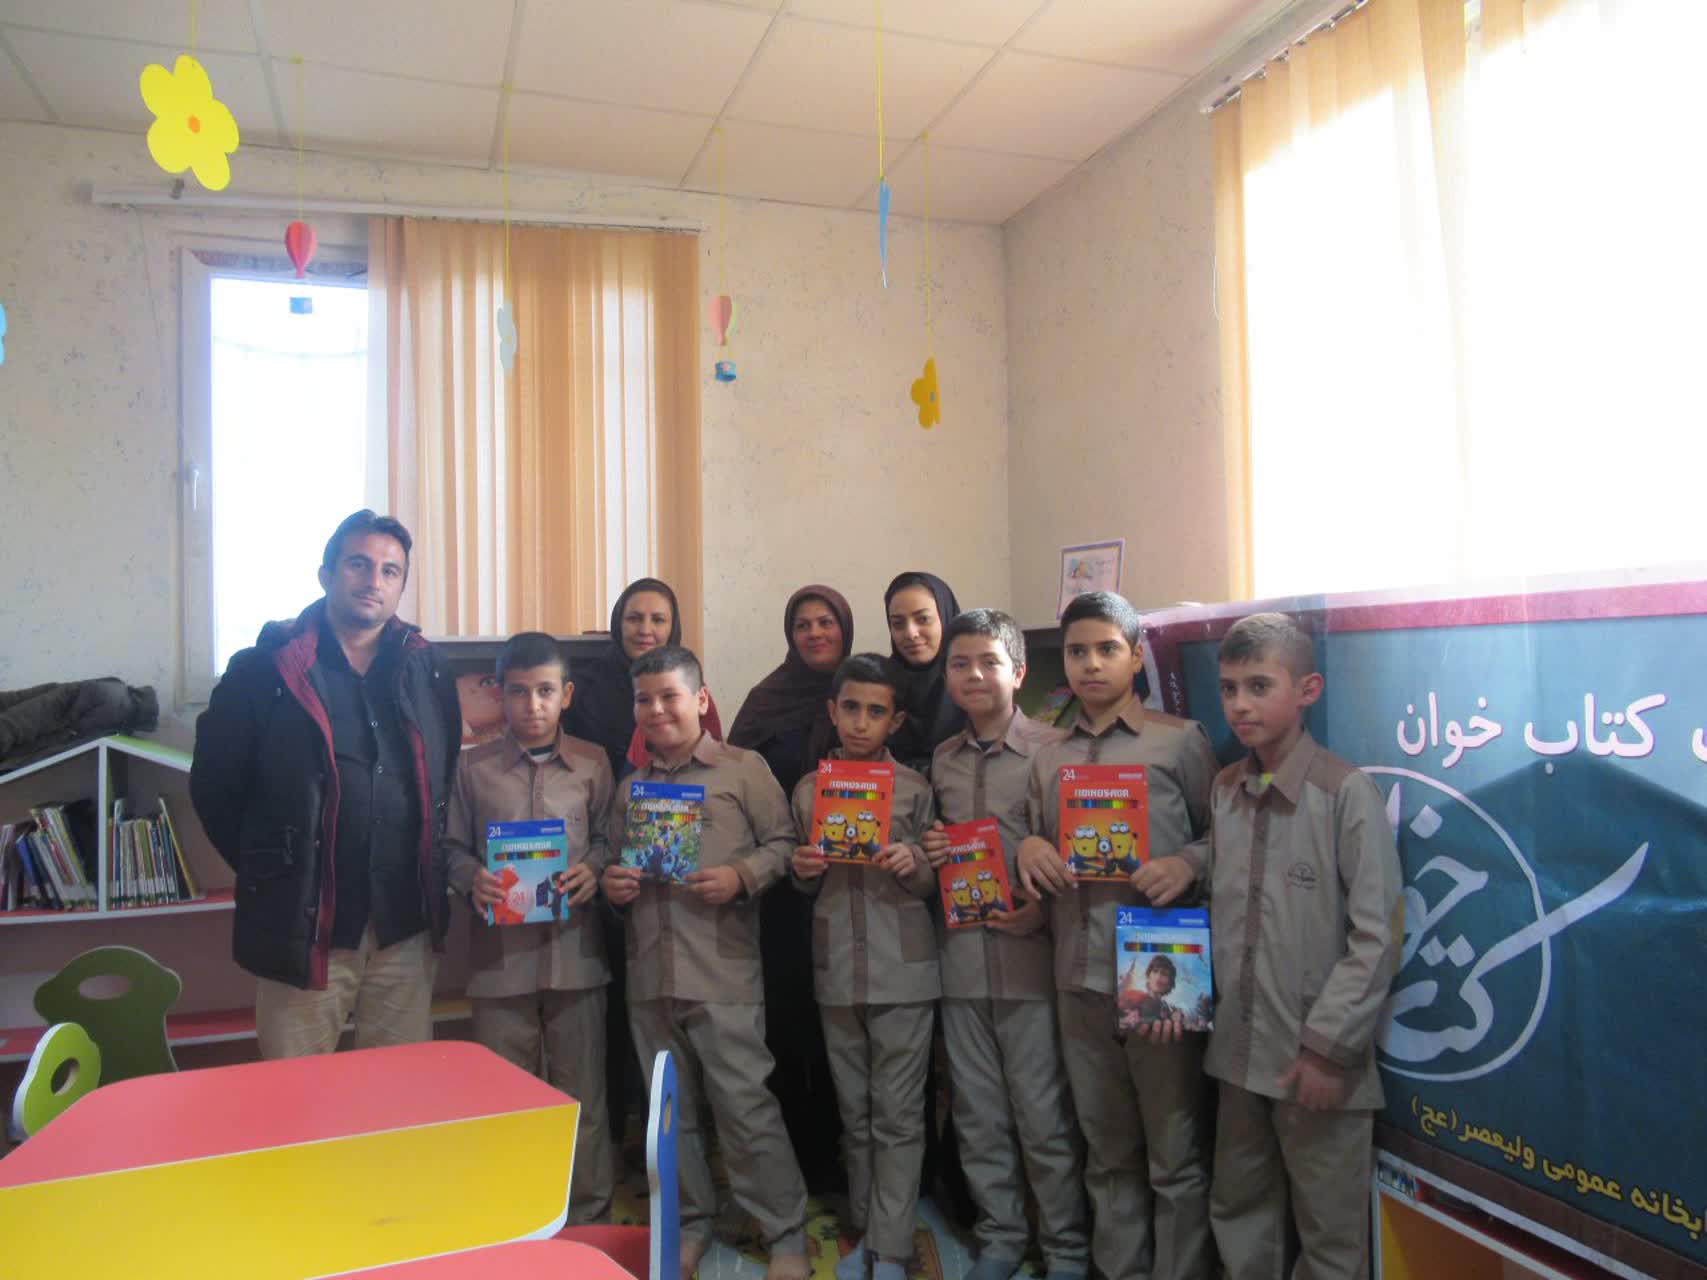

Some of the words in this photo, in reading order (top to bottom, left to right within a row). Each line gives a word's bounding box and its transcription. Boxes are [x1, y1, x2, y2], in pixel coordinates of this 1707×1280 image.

[1396, 691, 1503, 769] خوان
[1523, 692, 1668, 775] کتاب
[821, 763, 832, 774] 24
[1062, 768, 1076, 781] 24
[632, 784, 645, 796] 24
[488, 826, 501, 838] 24
[1119, 911, 1133, 924] 24
[1458, 1122, 1537, 1170] ولیعصر
[1542, 1158, 1624, 1201] عمومی
